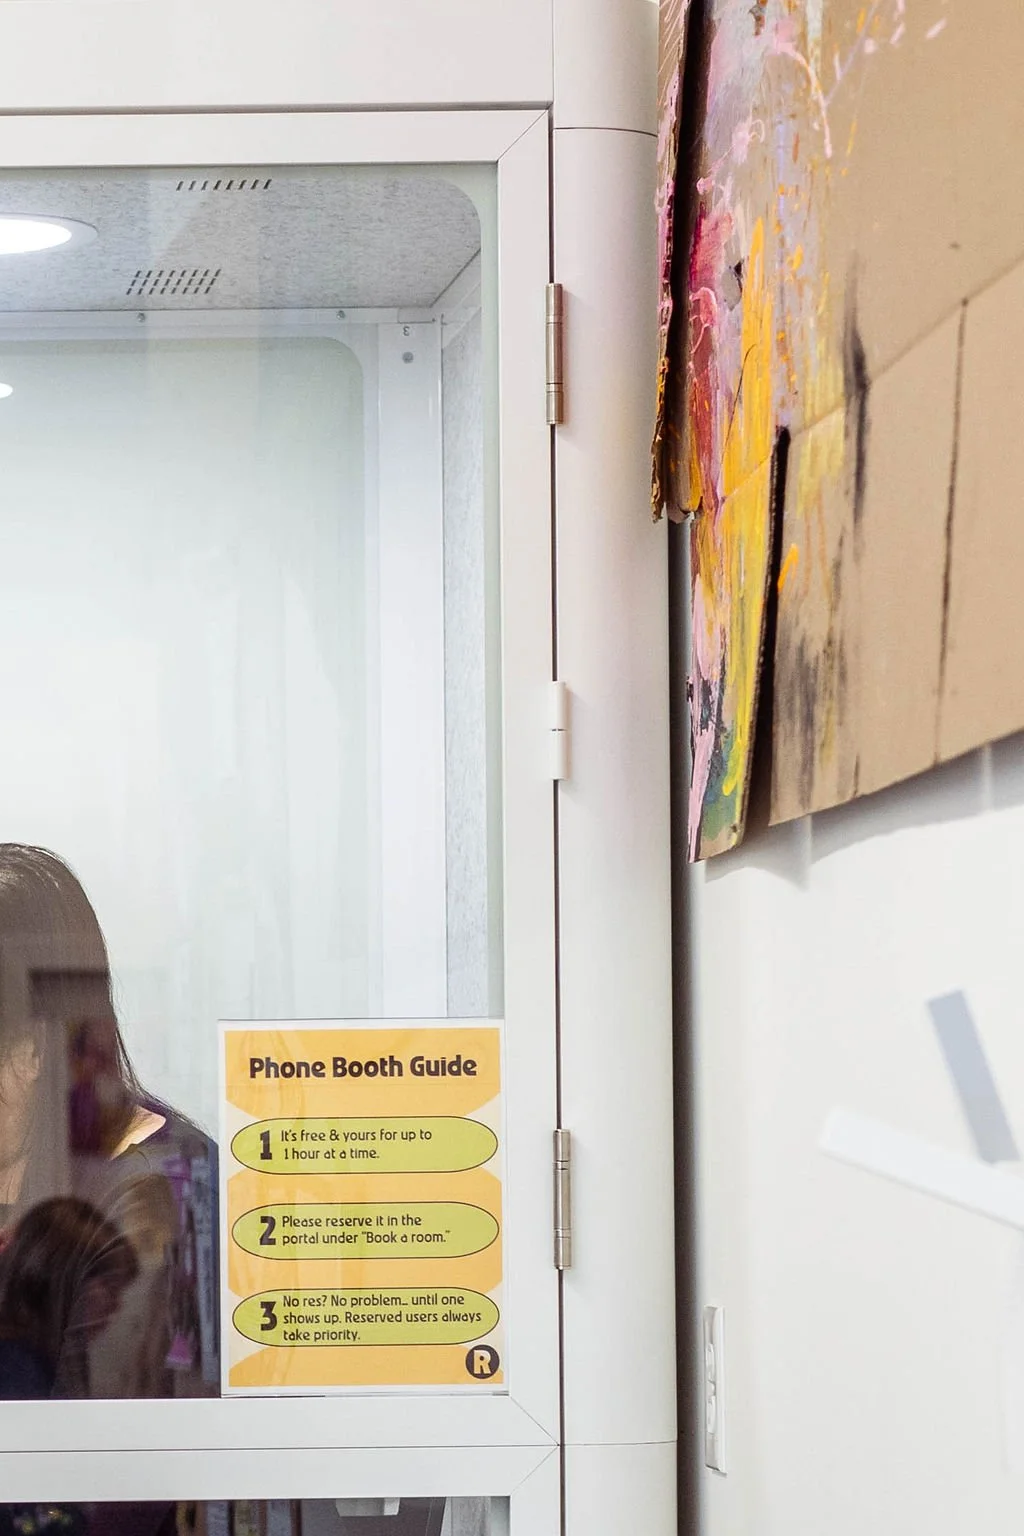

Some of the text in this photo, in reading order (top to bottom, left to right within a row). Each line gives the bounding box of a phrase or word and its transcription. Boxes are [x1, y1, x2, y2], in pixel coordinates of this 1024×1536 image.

[250, 1054, 478, 1079] Phone Booth Guide
[281, 1129, 432, 1142] It's free & yours for up to
[260, 1130, 273, 1161] 1
[284, 1147, 380, 1160] 1 hour at a time.
[282, 1214, 422, 1228] Please reserve it in the
[259, 1216, 276, 1246] 2
[282, 1230, 451, 1245] portal under "Book a room."
[283, 1295, 300, 1307] No
[303, 1295, 328, 1307] res?
[331, 1295, 348, 1307] No
[412, 1294, 438, 1306] until
[441, 1296, 465, 1306] one
[260, 1301, 278, 1331] 3
[283, 1310, 482, 1325] shows up. Reserved users always
[283, 1329, 361, 1342] take priority.
[473, 1350, 492, 1375] R
